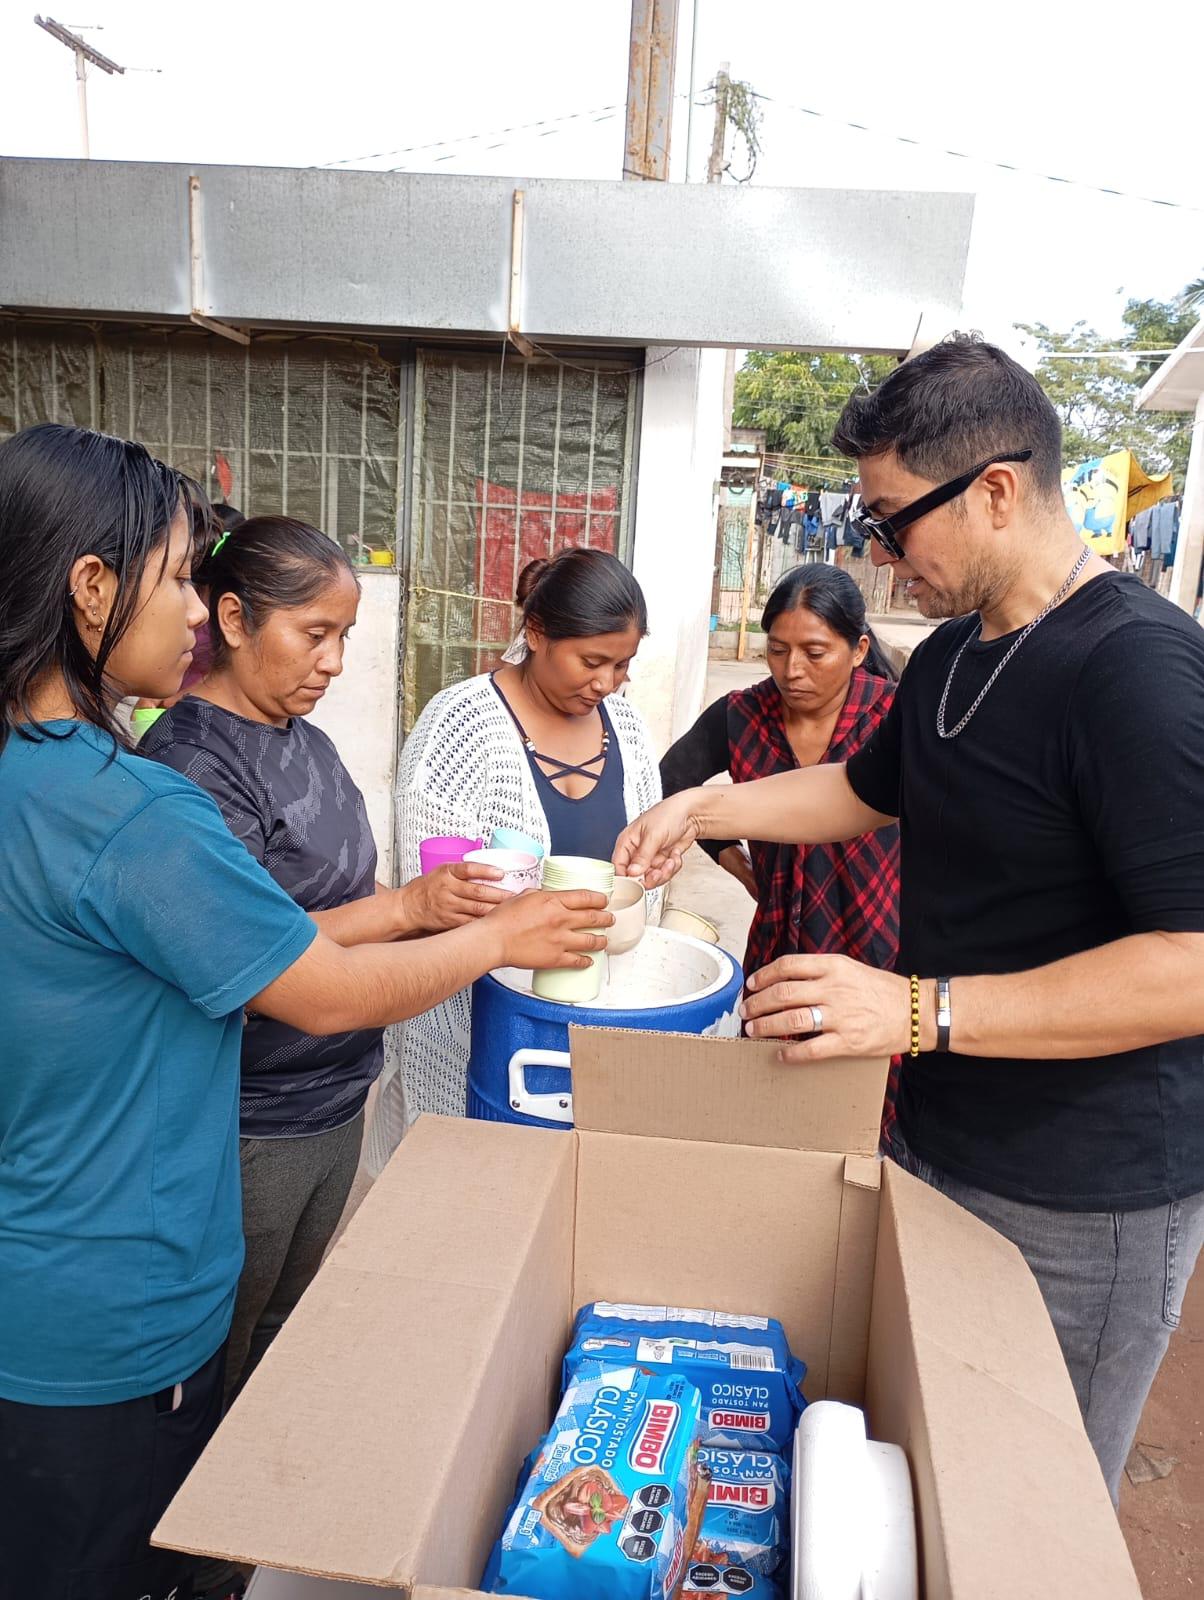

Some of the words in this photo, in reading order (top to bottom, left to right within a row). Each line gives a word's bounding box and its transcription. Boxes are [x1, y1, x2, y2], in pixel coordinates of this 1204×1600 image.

[712, 1384, 769, 1399] CLÁSICO
[622, 1391, 639, 1412] PAN
[711, 1398, 749, 1407] TOSTADO
[752, 1401, 769, 1409] PAN
[573, 1386, 621, 1464] CLÁSICO
[712, 1413, 766, 1430] BIMBO
[601, 1417, 629, 1468] TOSTADO
[635, 1404, 674, 1469] BIMBO
[697, 1449, 772, 1468] CLÁSIC
[713, 1466, 739, 1476] TOS
[745, 1469, 773, 1479] PAN
